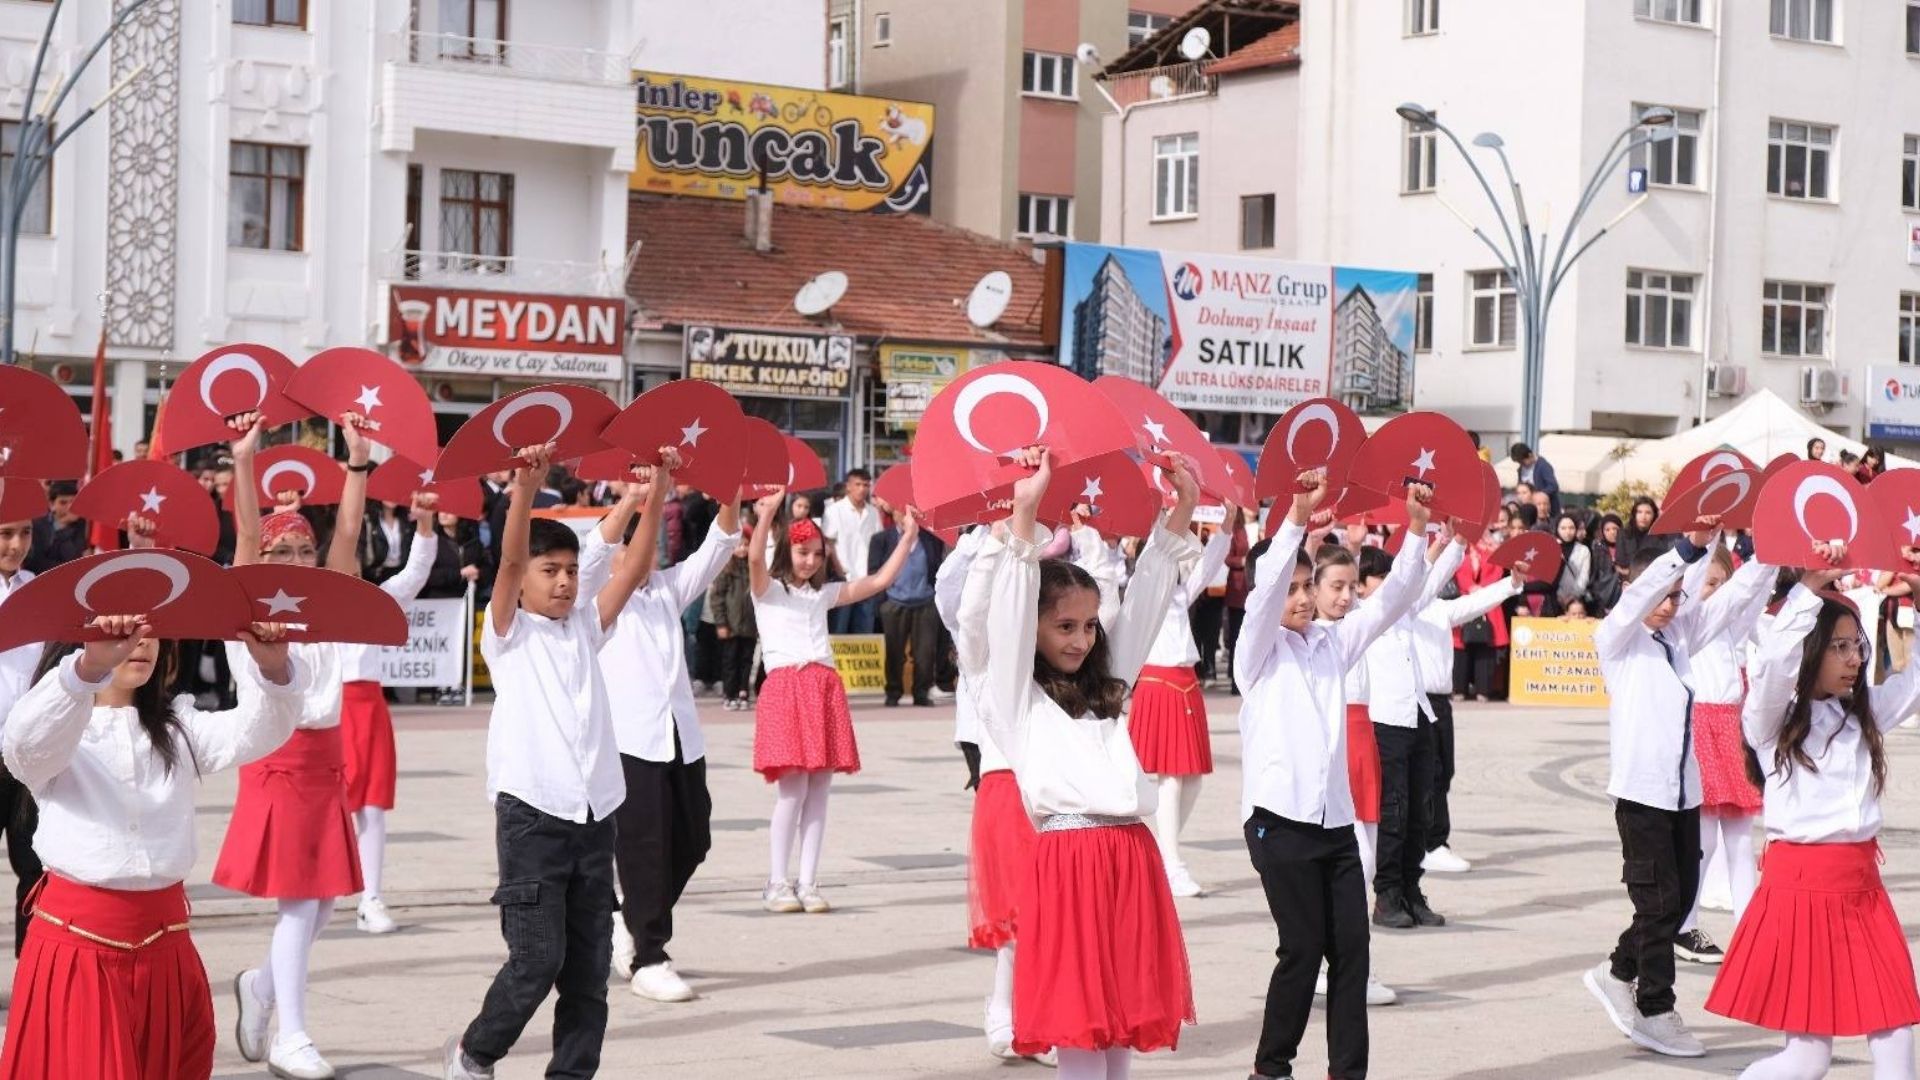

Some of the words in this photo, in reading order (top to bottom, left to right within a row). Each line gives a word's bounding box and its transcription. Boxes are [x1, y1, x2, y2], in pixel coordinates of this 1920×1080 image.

[1211, 269, 1271, 299] MANZ
[1277, 275, 1327, 306] Grup
[435, 296, 616, 345] MEYDAN
[1198, 306, 1262, 333] Dolunay
[1267, 307, 1317, 335] İnşaat
[447, 350, 490, 370] Okey
[493, 355, 511, 367] ve
[515, 353, 546, 373] Çay
[550, 354, 608, 373] Salonu
[733, 334, 827, 366] TUTKUM
[1198, 337, 1305, 369] SATILIK
[689, 363, 754, 382] ERKEK
[758, 366, 849, 389] KUAFÖRÜ
[1175, 371, 1217, 387] ULTRA
[1221, 371, 1254, 389] LÜKS
[1256, 373, 1321, 393] DAİRELER
[390, 658, 436, 679] LİSESİ
[1567, 667, 1603, 677] ANAD
